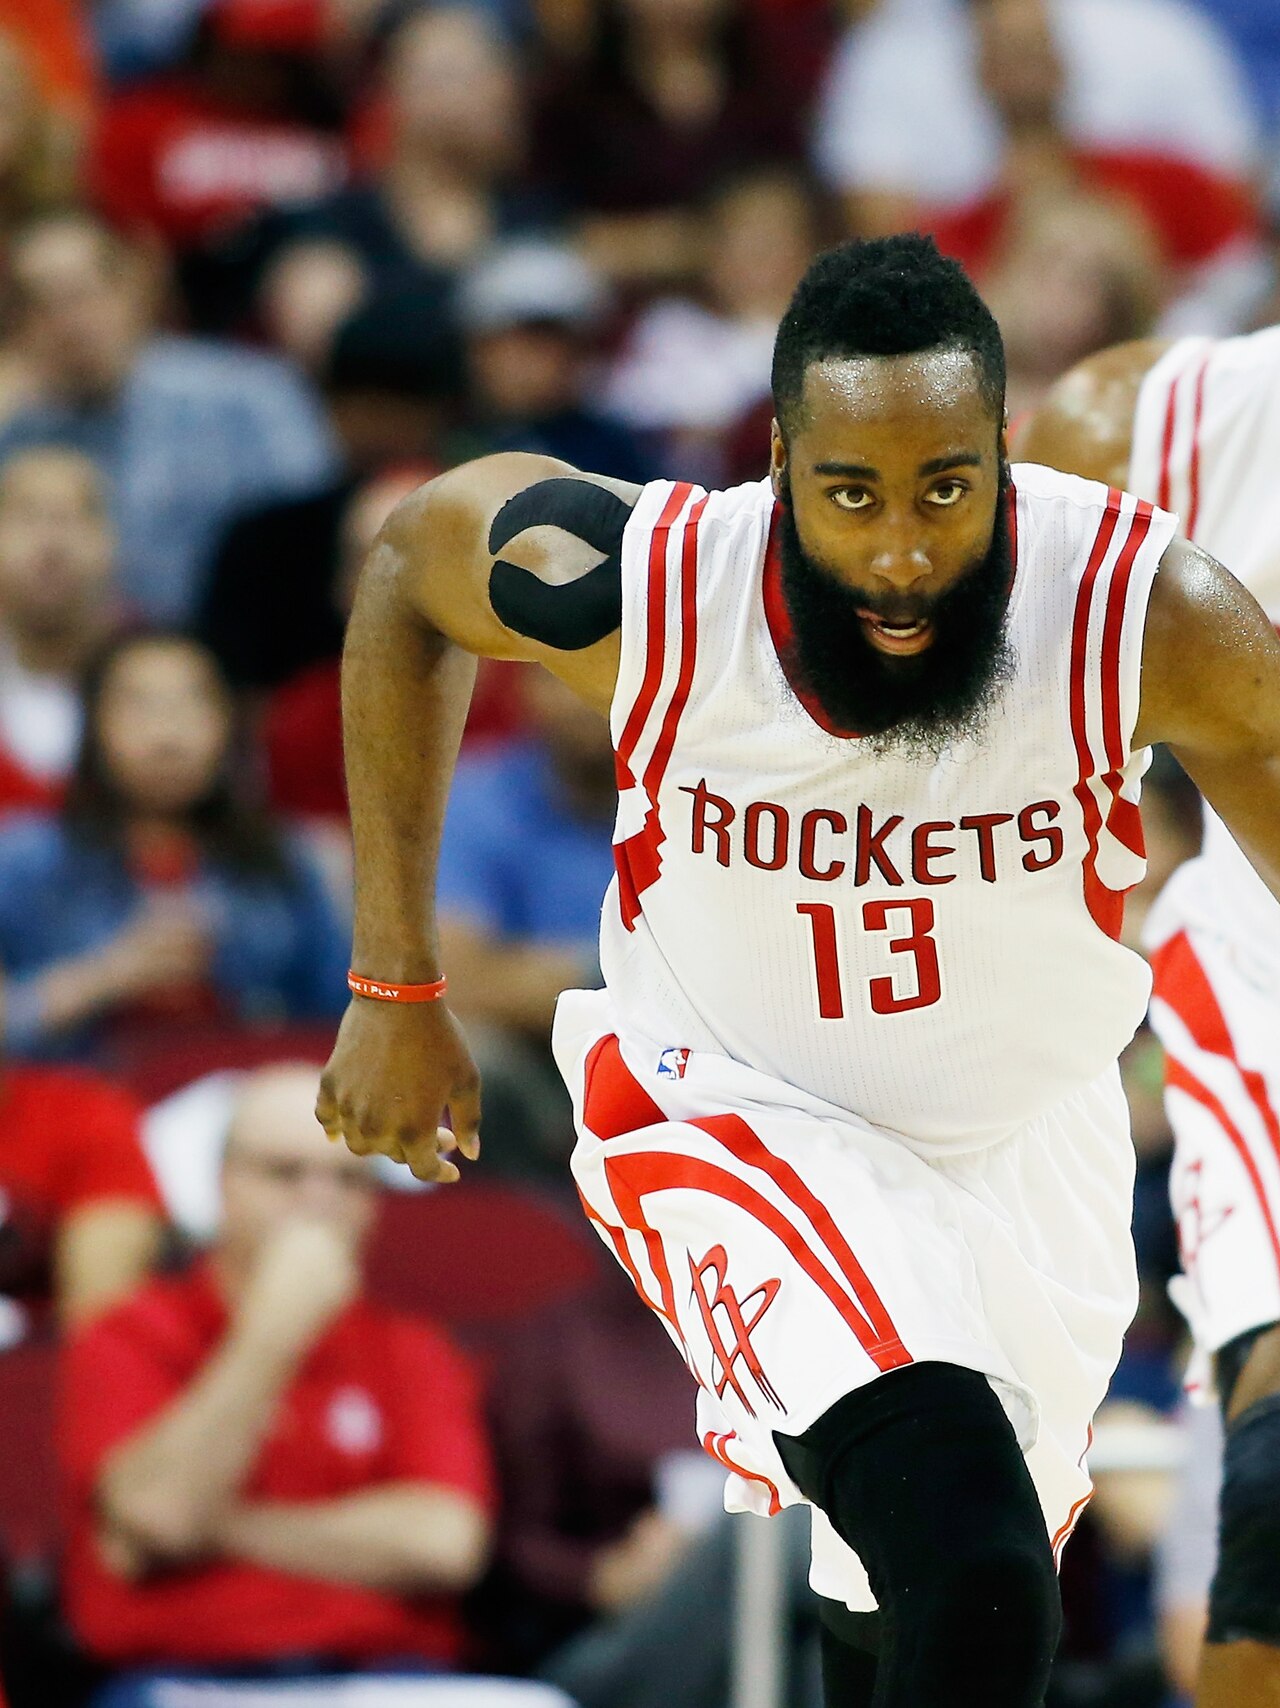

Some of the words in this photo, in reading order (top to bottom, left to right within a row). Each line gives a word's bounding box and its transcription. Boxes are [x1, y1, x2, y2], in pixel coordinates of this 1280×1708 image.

[678, 778, 1064, 887] ROCKETS
[370, 985, 400, 998] PLAY
[796, 897, 942, 1020] 13
